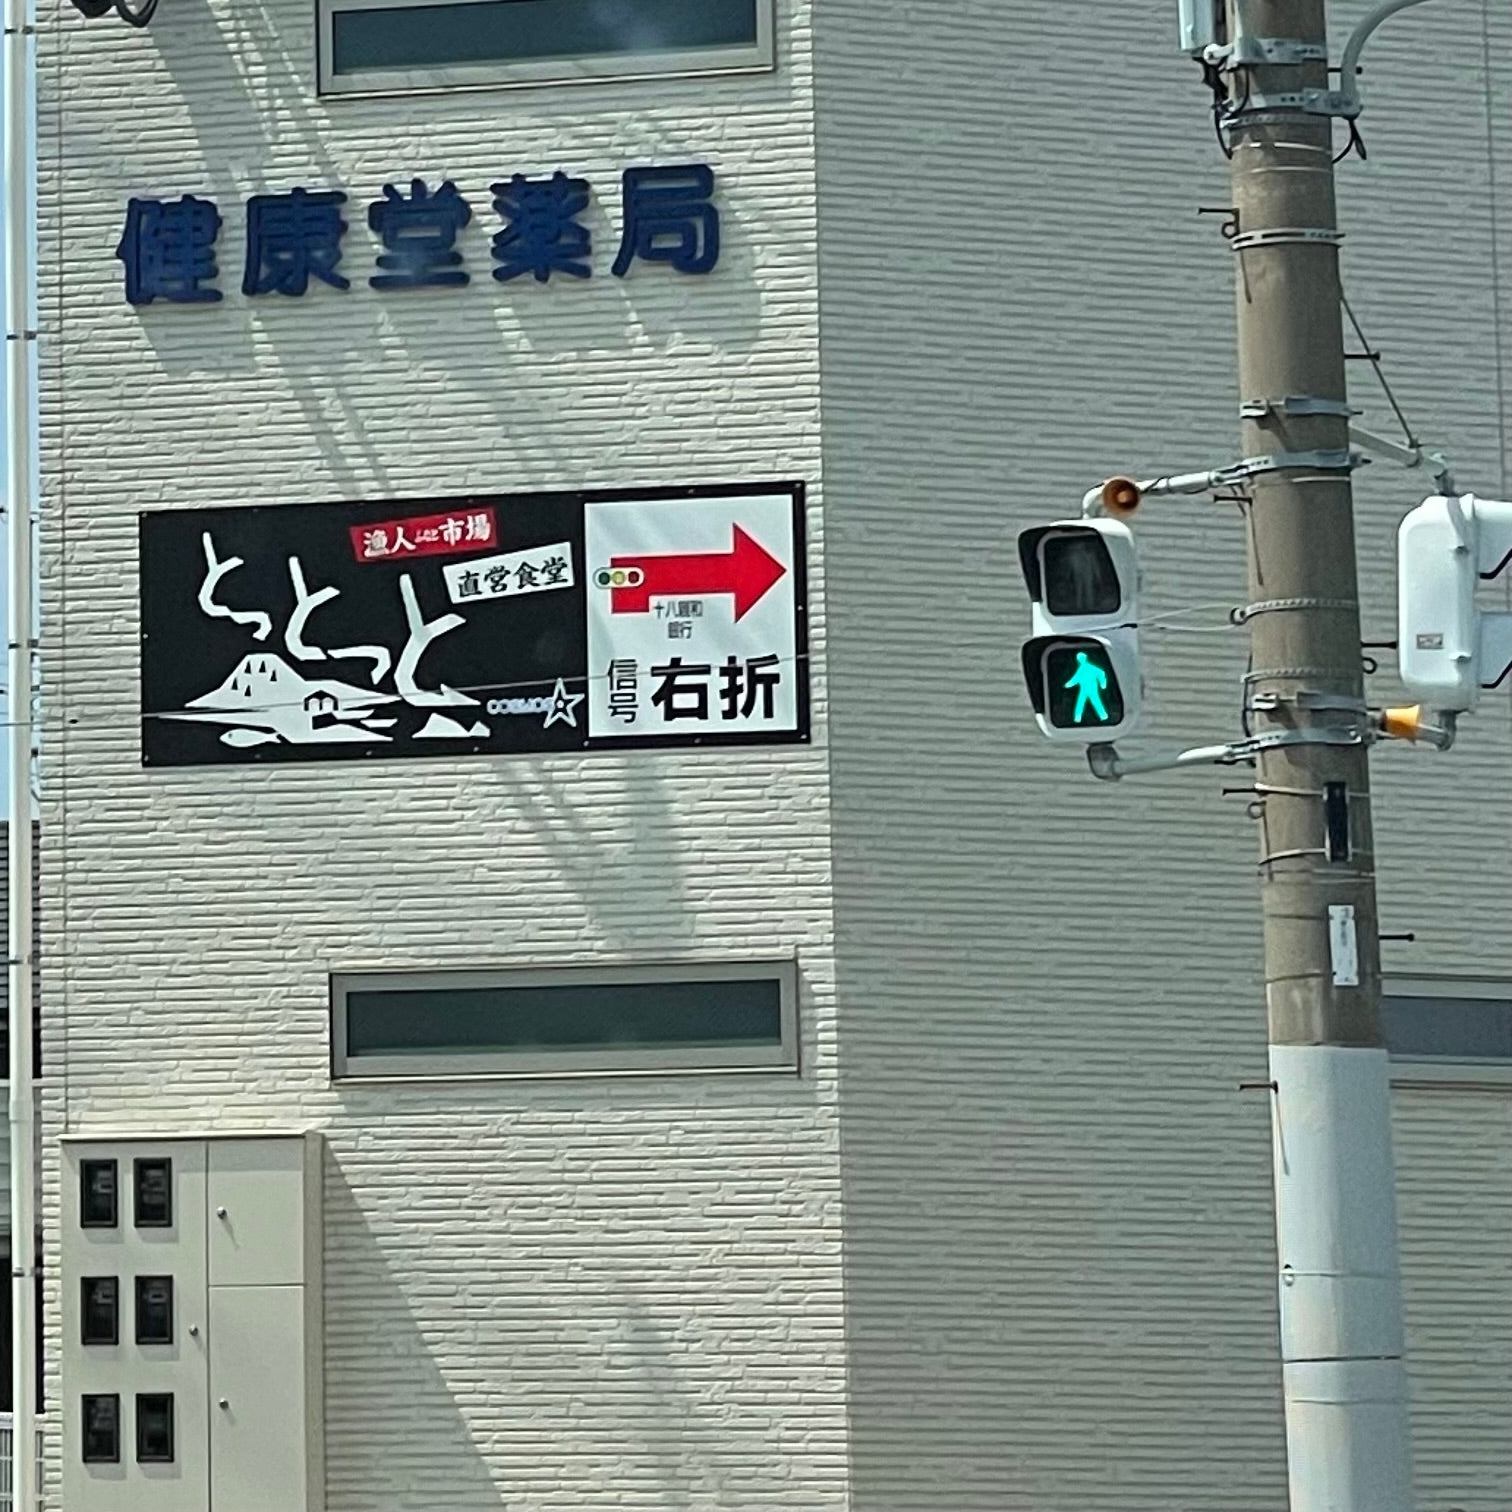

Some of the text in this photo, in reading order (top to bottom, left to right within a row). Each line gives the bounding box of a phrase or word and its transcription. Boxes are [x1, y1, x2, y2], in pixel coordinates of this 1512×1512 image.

[117, 163, 719, 305] 健康堂薬局
[457, 556, 568, 598] 直営食堂
[607, 653, 781, 724] 信号 右折
